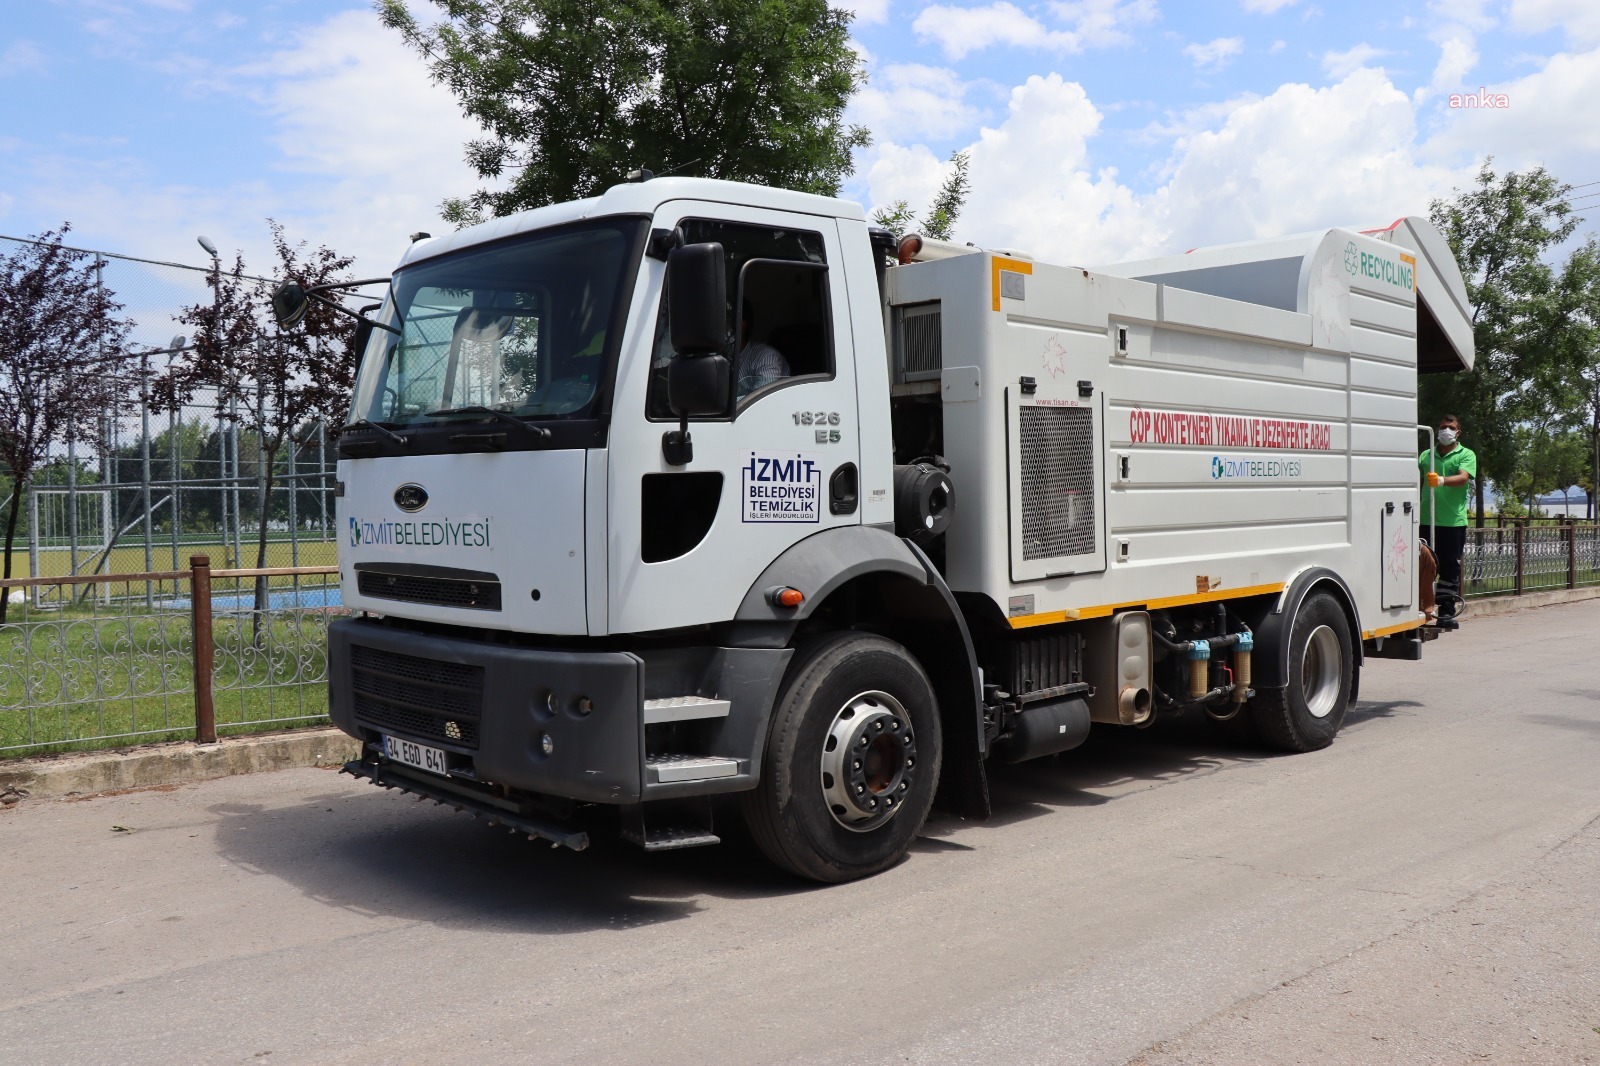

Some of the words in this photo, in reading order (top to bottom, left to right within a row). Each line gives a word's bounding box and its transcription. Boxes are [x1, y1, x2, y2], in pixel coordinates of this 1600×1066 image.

[1360, 251, 1413, 290] RECYCLING
[1035, 397, 1079, 407] www.tisan.eu
[792, 411, 841, 426] 1826
[815, 430, 841, 443] E5
[1215, 416, 1248, 447] YIKAMA
[1249, 418, 1261, 448] VE
[1262, 419, 1309, 450] DEZENFEKTE
[1310, 423, 1331, 451] ARACI
[750, 452, 814, 483] İZMİT
[750, 484, 815, 499] BELEDİYESİ
[750, 500, 814, 512] TEMİZLİK
[387, 737, 399, 759] 34
[402, 741, 421, 766] EGD
[425, 748, 445, 773] 641
